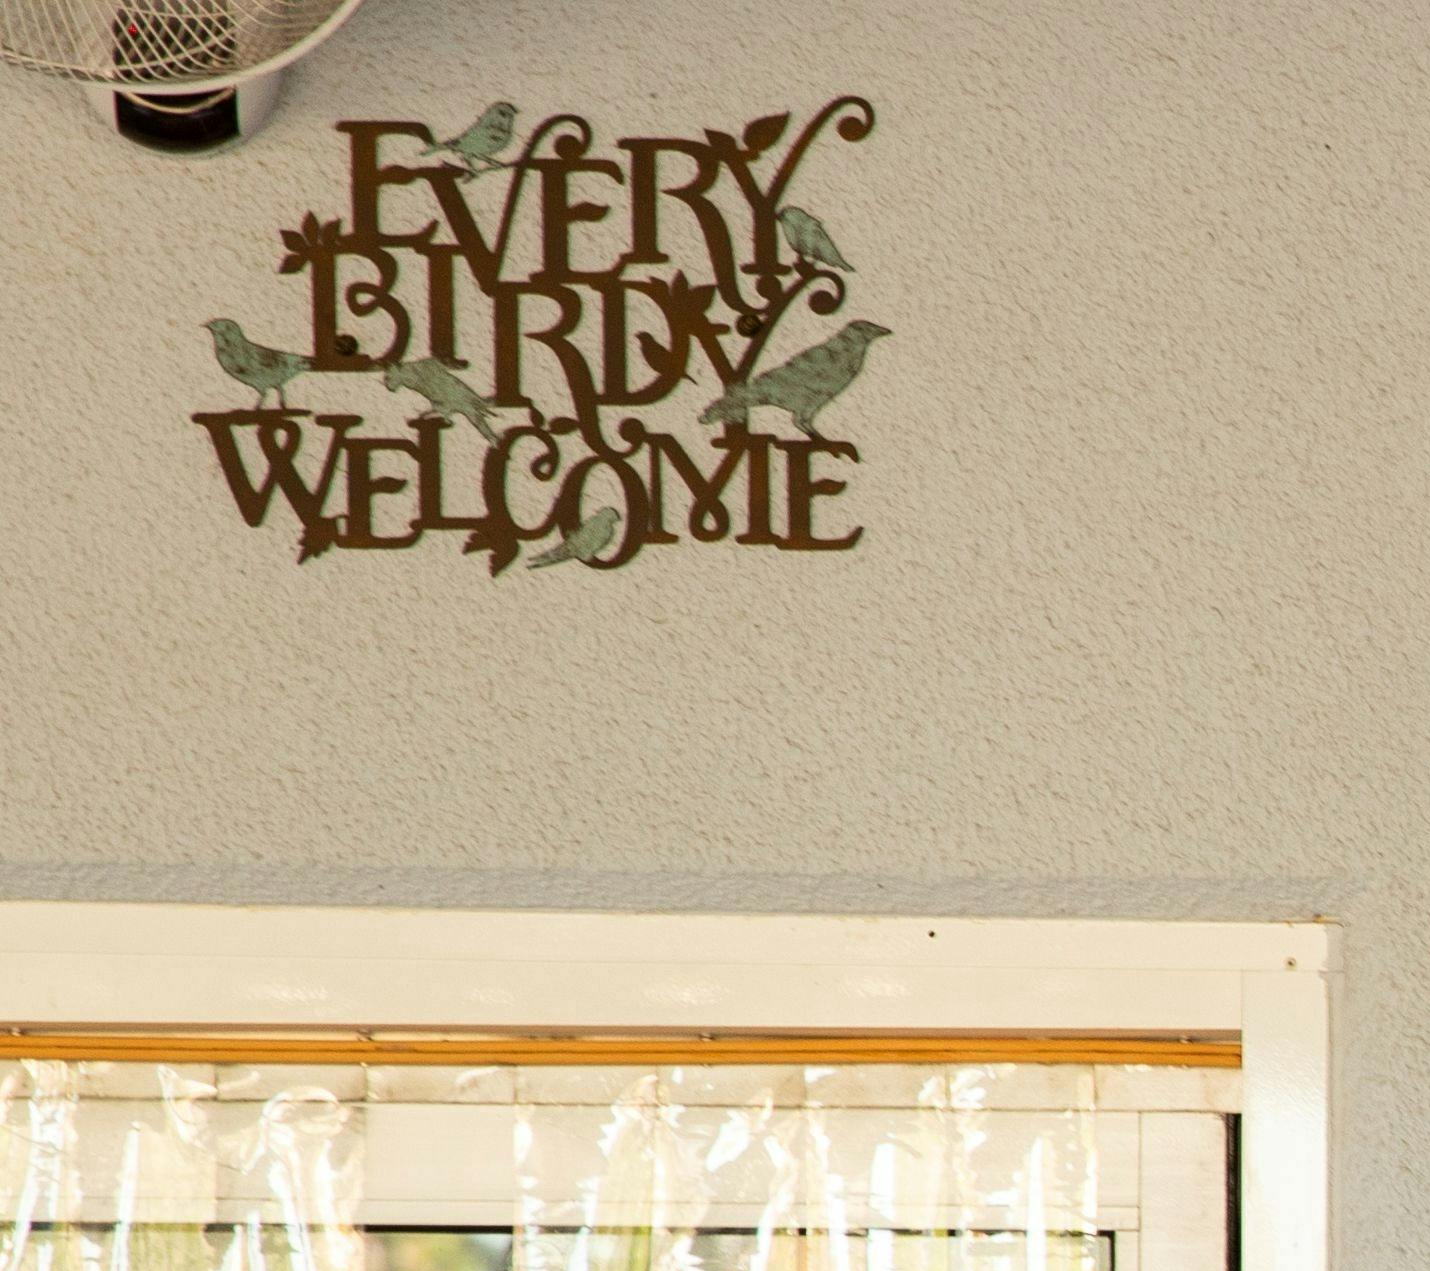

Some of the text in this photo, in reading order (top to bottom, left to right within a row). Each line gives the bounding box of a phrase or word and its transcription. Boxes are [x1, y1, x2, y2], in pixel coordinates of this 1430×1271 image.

[336, 95, 875, 318] EVERY
[300, 243, 846, 450] BIRDY
[192, 410, 863, 570] WELCOME
